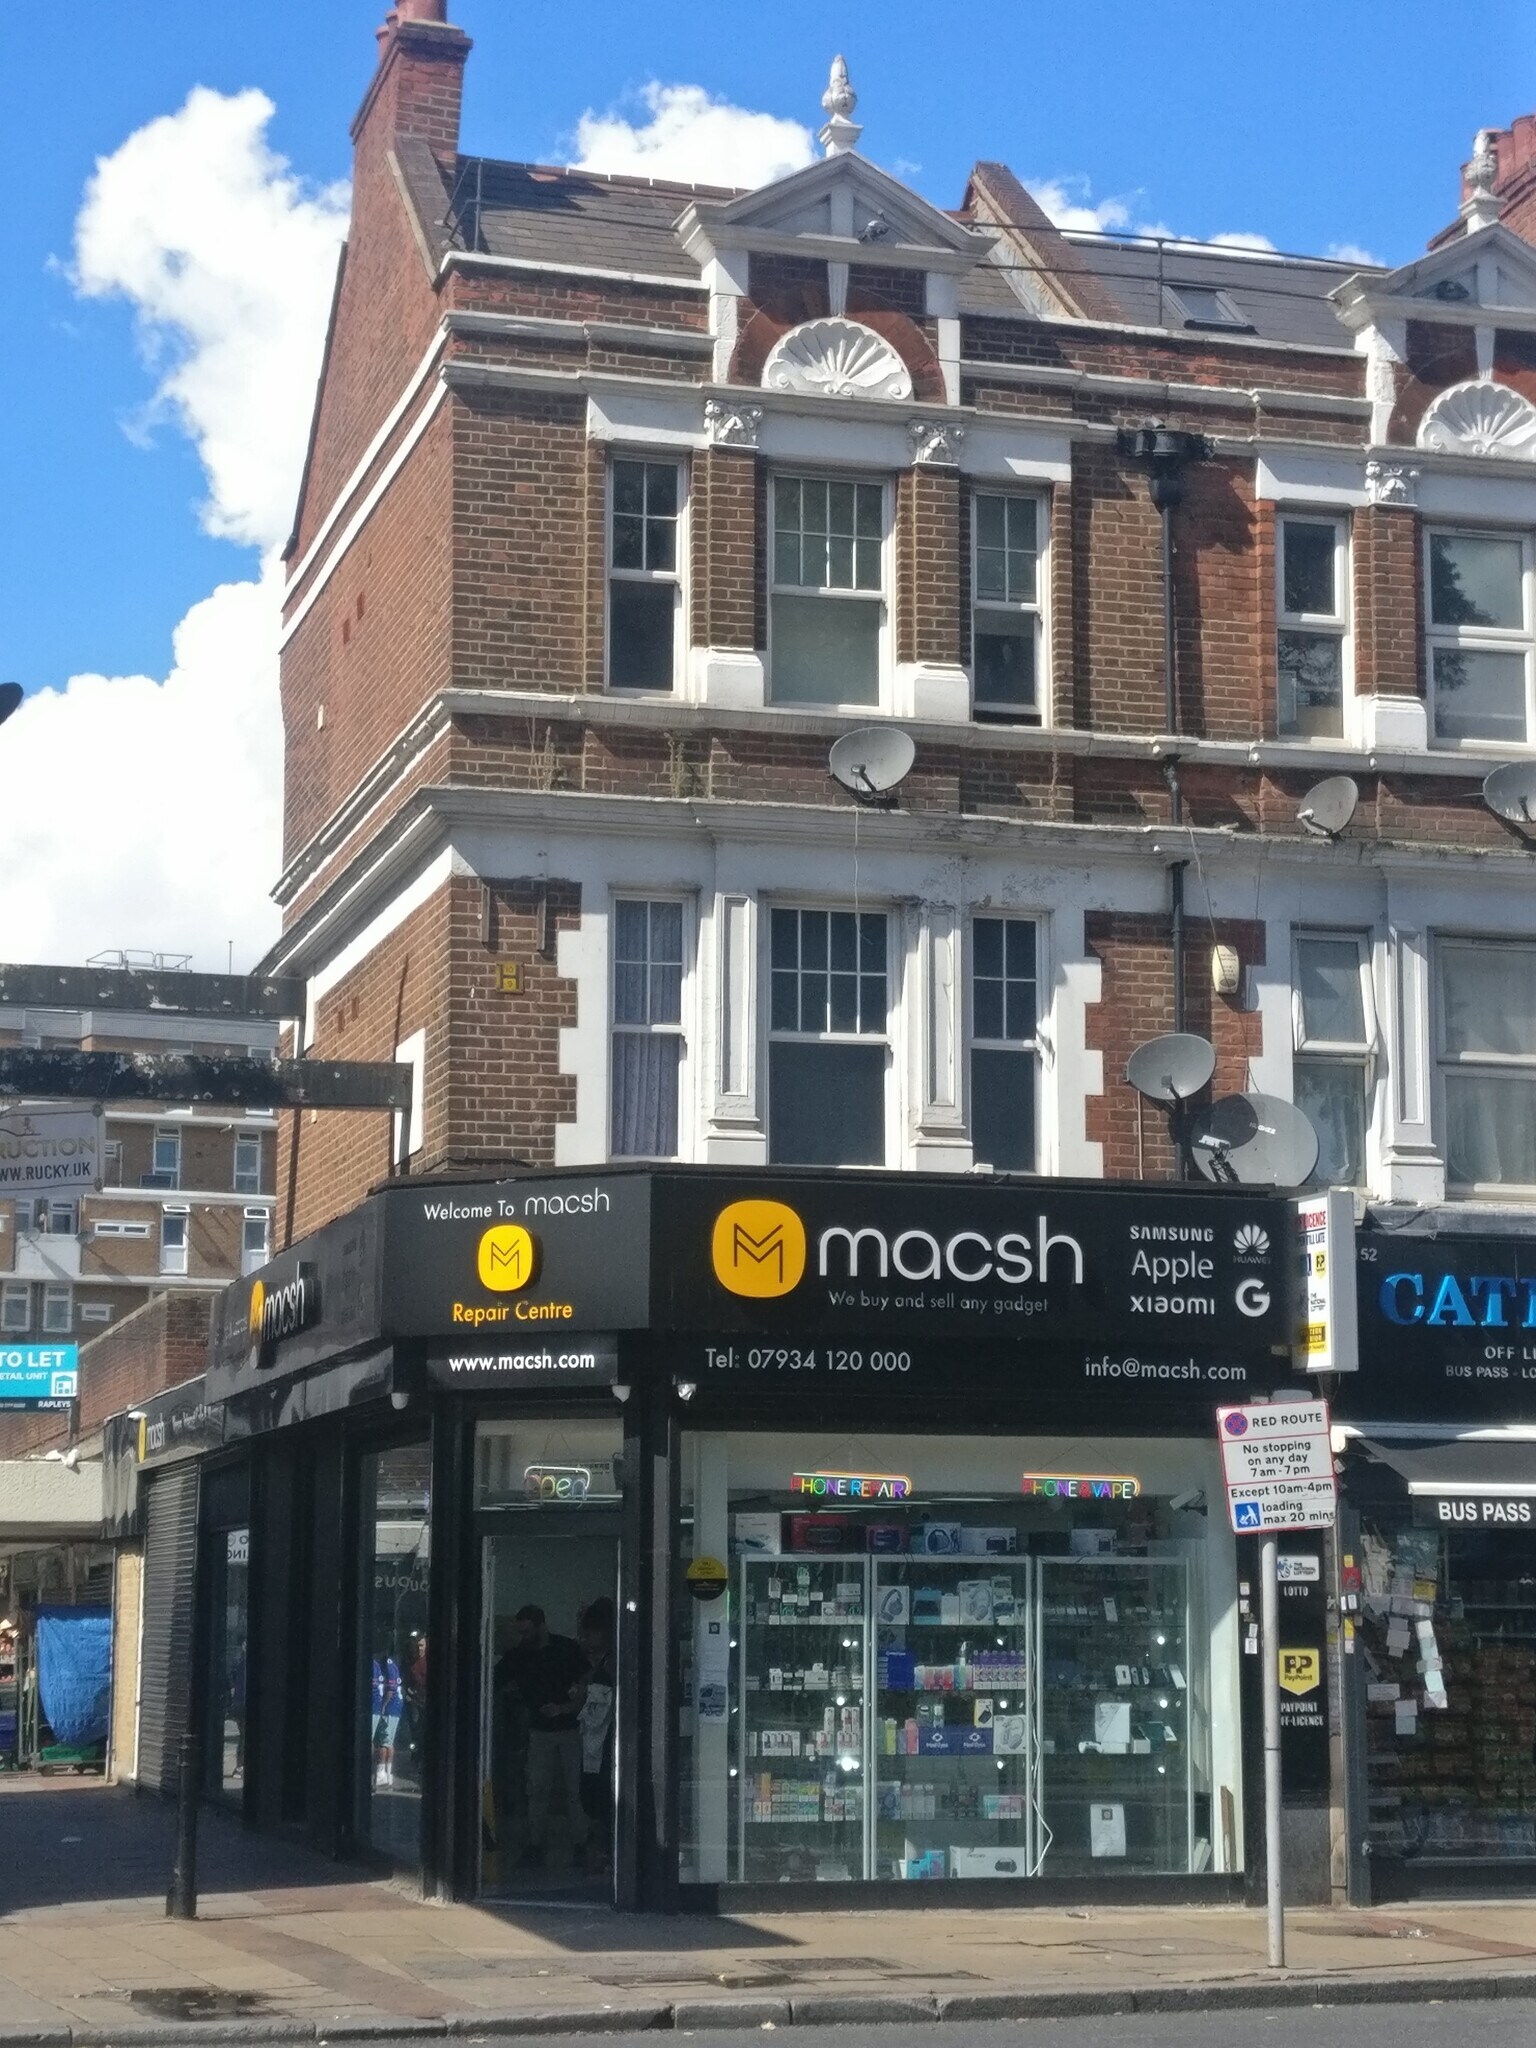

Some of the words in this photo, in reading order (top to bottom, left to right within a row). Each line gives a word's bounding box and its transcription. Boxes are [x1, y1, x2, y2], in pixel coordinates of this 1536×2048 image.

[424, 1202, 492, 1220] Welcome
[498, 1200, 515, 1216] To
[525, 1187, 610, 1216] macsh
[1130, 1225, 1214, 1242] SAMSUNG
[818, 1215, 1083, 1284] macsh
[1360, 1248, 1378, 1261] 52
[1131, 1249, 1214, 1284] Apple
[264, 1261, 304, 1341] macsh
[829, 1290, 855, 1306] We
[860, 1290, 889, 1311] buy
[895, 1292, 924, 1308] and
[930, 1293, 954, 1309] sell
[960, 1298, 987, 1314] any
[993, 1296, 1048, 1316] gadget
[1235, 1278, 1270, 1317] G
[453, 1302, 509, 1327] Repair
[515, 1301, 573, 1320] Centre
[27, 1351, 66, 1367] LET
[449, 1348, 595, 1372] www.macsh.com
[705, 1347, 740, 1369] Tel:
[748, 1349, 816, 1370] 07934
[826, 1351, 863, 1371] 120
[870, 1352, 911, 1372] 000
[1485, 1346, 1515, 1360] OFF
[25, 1372, 48, 1380] UNIT
[1085, 1356, 1247, 1380] info@macsh.com
[1446, 1365, 1472, 1377] BUS
[1476, 1366, 1509, 1378] PASS
[38, 1400, 71, 1408] RAPLEYS
[1252, 1416, 1277, 1428] RED
[1281, 1412, 1323, 1425] ROUTE
[1243, 1444, 1259, 1454] No
[1263, 1440, 1311, 1454] stopping
[1265, 1456, 1285, 1465] any
[1288, 1453, 1308, 1464] day
[790, 1477, 847, 1496] PHONE
[850, 1479, 904, 1499] REPAIR
[1023, 1479, 1077, 1497] PHONE
[1092, 1481, 1132, 1499] VAPE
[1231, 1487, 1270, 1499] Except
[1273, 1482, 1332, 1494] 10am-4pm
[1262, 1502, 1303, 1513] loading
[1438, 1502, 1478, 1520] BUS
[1482, 1503, 1531, 1522] PASS
[1264, 1516, 1287, 1524] max
[1290, 1513, 1305, 1522] 20
[1309, 1511, 1335, 1521] mins
[1284, 1586, 1308, 1596] LOTTO
[1280, 1702, 1317, 1712] PAYPOINT
